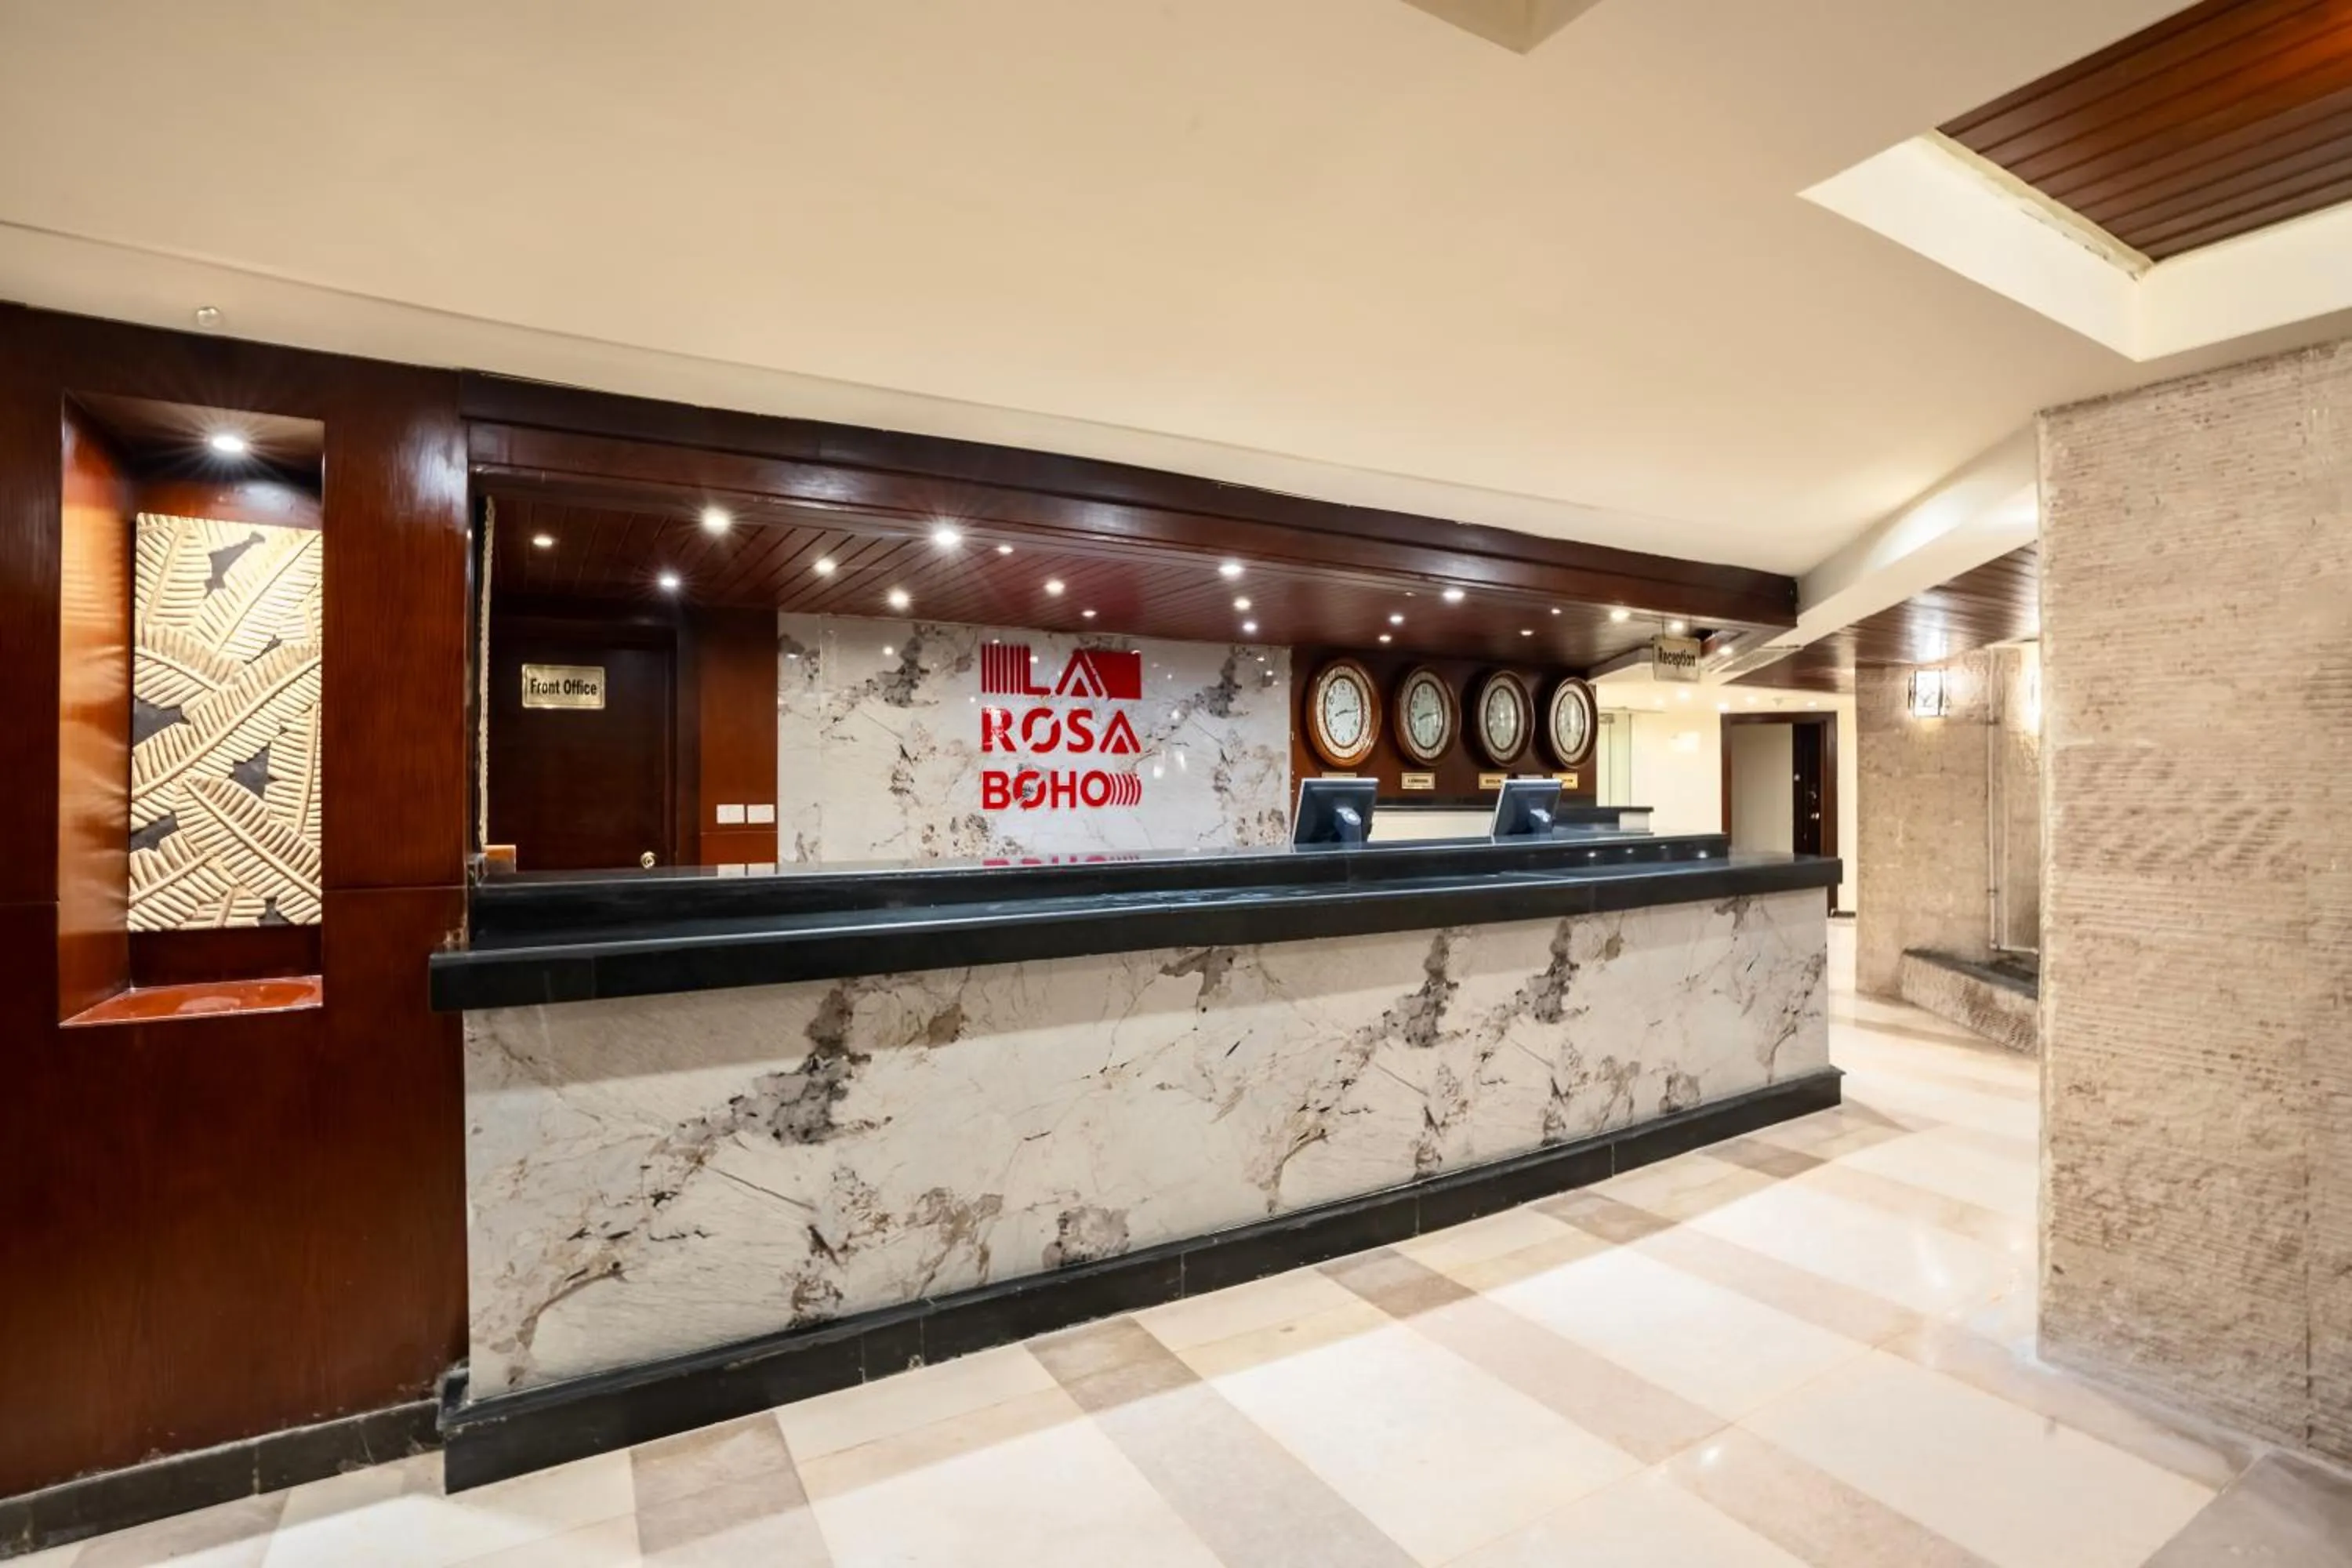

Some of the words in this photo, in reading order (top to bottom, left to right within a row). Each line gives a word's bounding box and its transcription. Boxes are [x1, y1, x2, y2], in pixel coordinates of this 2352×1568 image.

[1022, 644, 1103, 697] LA
[1658, 646, 1696, 670] Reception
[530, 678, 560, 695] Front
[563, 679, 597, 695] Office
[982, 708, 1141, 754] ROSA
[982, 770, 1111, 811] BOHO
